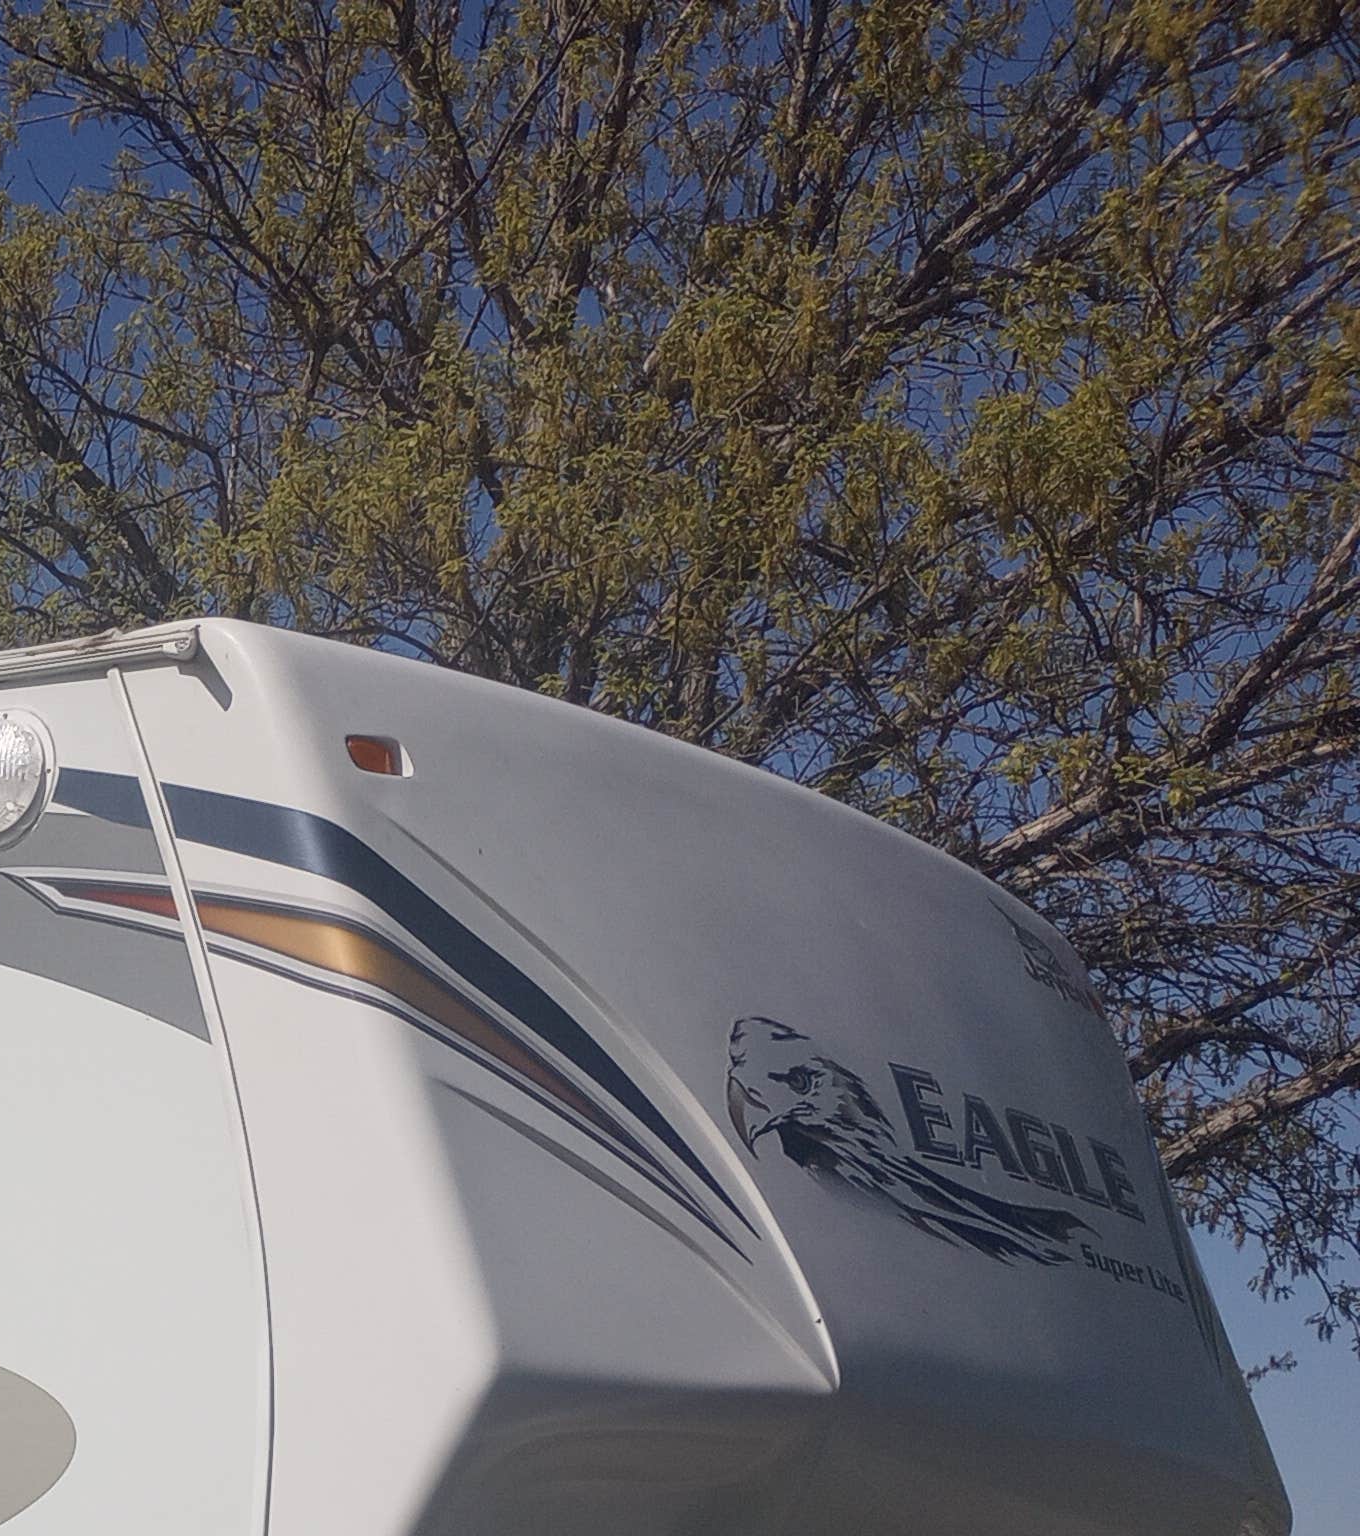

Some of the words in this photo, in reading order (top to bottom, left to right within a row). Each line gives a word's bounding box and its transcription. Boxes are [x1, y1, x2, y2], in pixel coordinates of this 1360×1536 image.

[888, 1061, 1146, 1225] EAGLE
[1080, 1243, 1144, 1284] Super
[1146, 1265, 1186, 1304] Lite
